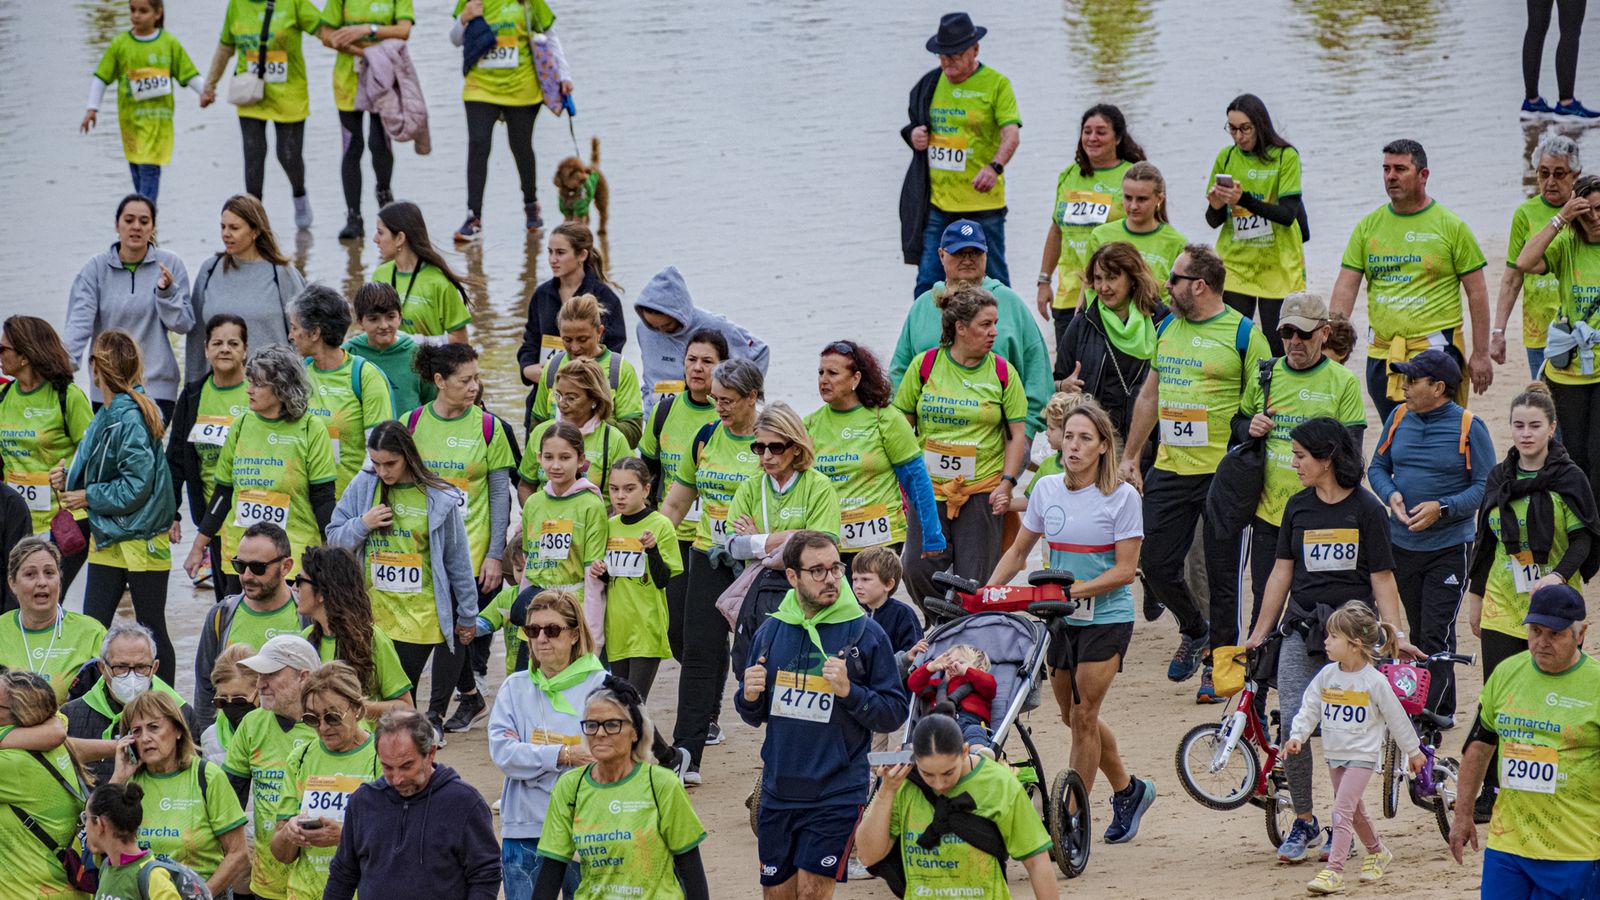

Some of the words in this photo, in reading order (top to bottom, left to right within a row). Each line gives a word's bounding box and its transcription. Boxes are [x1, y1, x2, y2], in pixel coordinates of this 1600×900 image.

[252, 62, 286, 76] 295
[137, 76, 168, 92] 2599
[930, 146, 964, 163] 3510
[1072, 202, 1108, 216] 2219
[1368, 254, 1382, 264] En
[1384, 253, 1422, 264] marcha
[1166, 354, 1203, 368] marcha
[1158, 365, 1181, 375] ontra
[938, 396, 979, 407] marcha
[921, 404, 955, 415] contra
[203, 424, 228, 438] 61
[1173, 422, 1194, 437] 54
[243, 456, 283, 467] marcha
[817, 452, 859, 463] marcha
[939, 455, 961, 470] 55
[697, 482, 725, 491] ontra
[240, 502, 286, 523] 3689
[844, 517, 888, 540] 3718
[609, 551, 642, 567] 1777
[1311, 543, 1356, 561] 4788
[377, 564, 420, 583] 4610
[780, 687, 832, 711] 4776
[1324, 703, 1366, 723] 4790
[1497, 713, 1513, 724] En
[1514, 715, 1561, 733] marcha
[1496, 727, 1535, 739] contra
[1508, 758, 1555, 782] 2900
[308, 791, 351, 812] 364
[584, 830, 632, 843] marcha
[578, 845, 608, 857] ontra
[592, 856, 625, 869] áncer
[916, 857, 960, 870] cáncer
